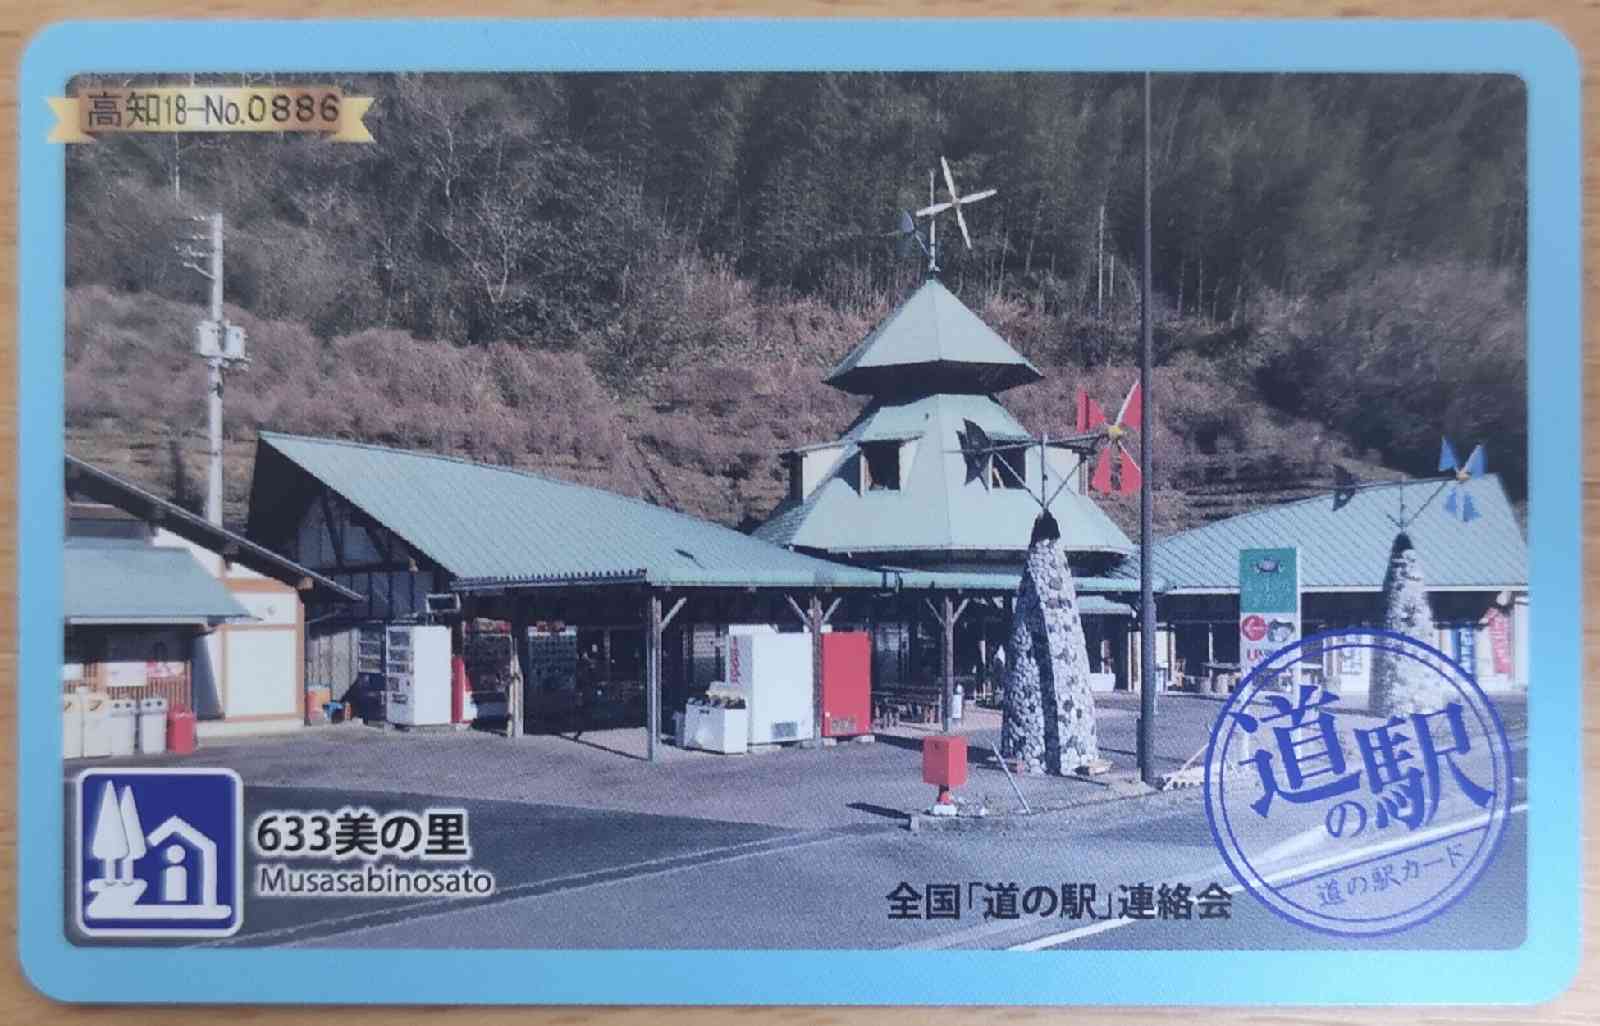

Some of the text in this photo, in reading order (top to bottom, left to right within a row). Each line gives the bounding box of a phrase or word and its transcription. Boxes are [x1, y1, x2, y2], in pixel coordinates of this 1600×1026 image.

[1228, 685, 1497, 839] 道の駅
[257, 813, 467, 856] 633美の里
[259, 867, 492, 894] Musasabinosato
[1316, 843, 1466, 907] 道の駅カード
[885, 881, 1233, 920] 全国「道の駅」連絡会
